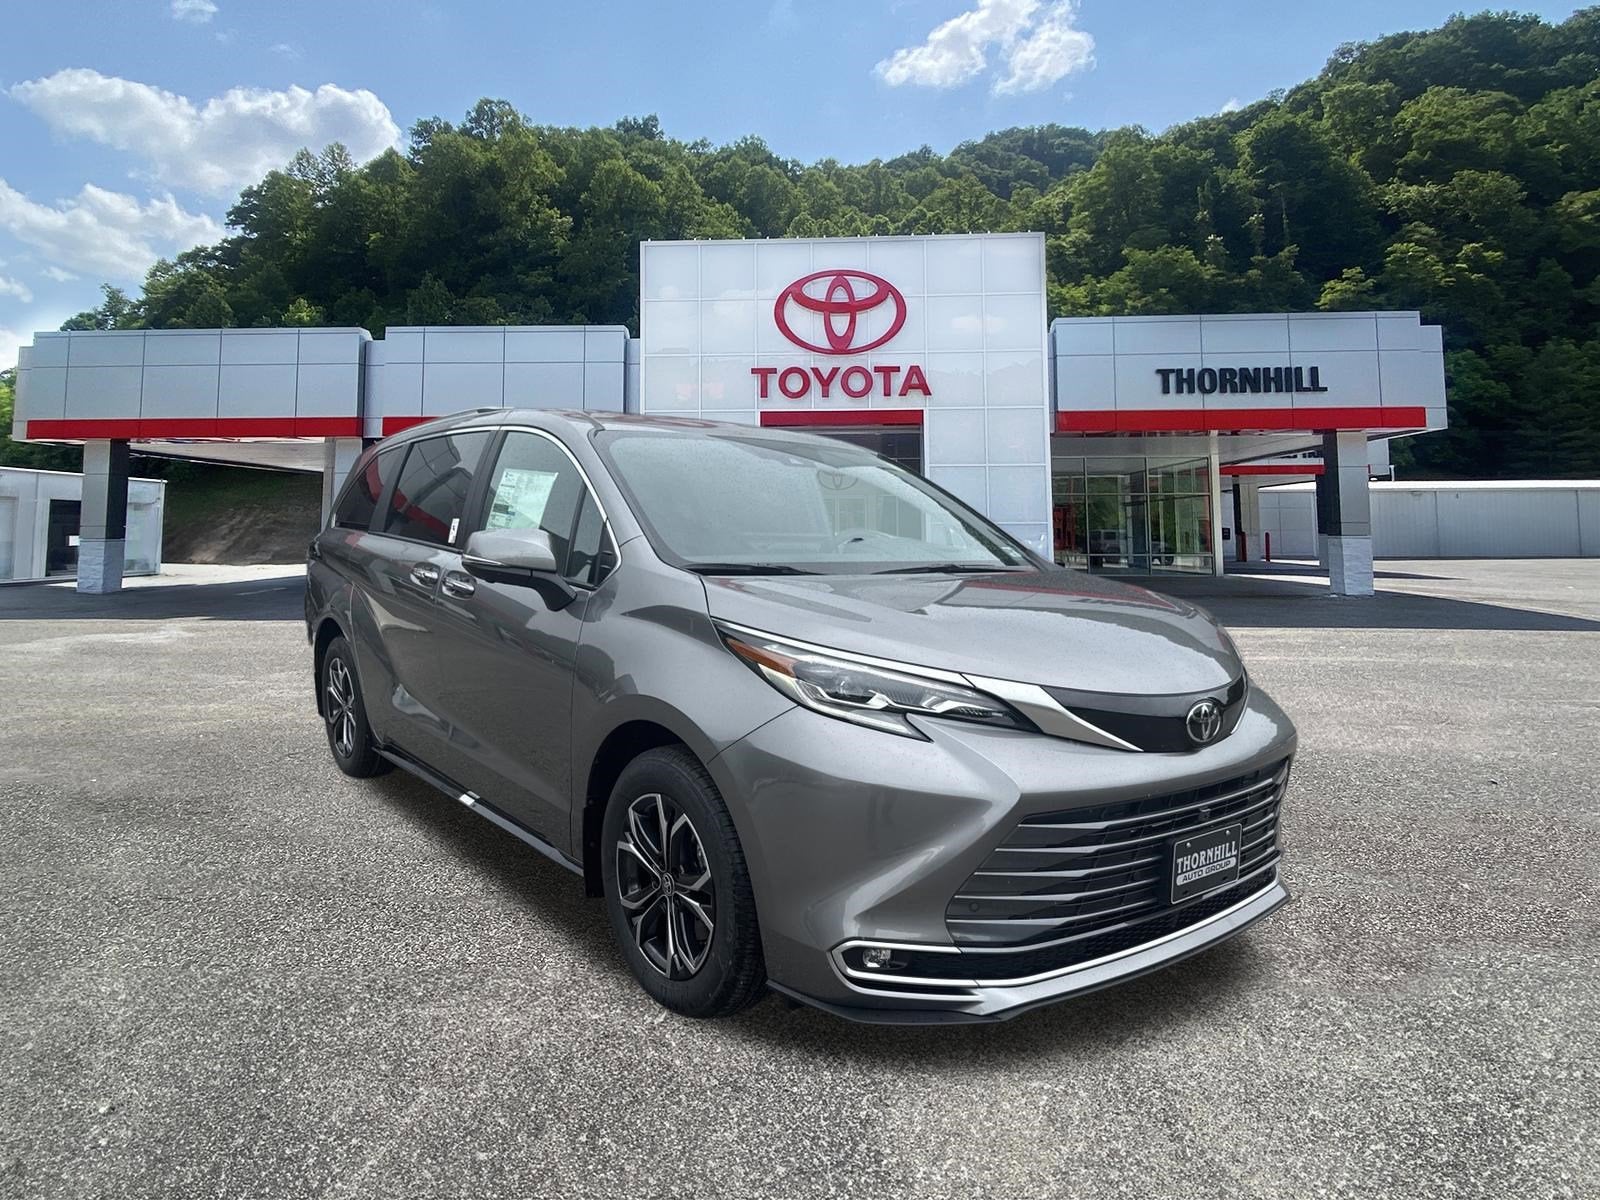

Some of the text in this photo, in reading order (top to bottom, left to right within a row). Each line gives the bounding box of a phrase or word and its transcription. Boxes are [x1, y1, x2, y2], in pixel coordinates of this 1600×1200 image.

[751, 365, 932, 399] TOYOTA
[1156, 366, 1328, 394] THORNHILL
[1177, 841, 1237, 873] THORNHILL
[1182, 860, 1231, 883] AUTO GROUP
